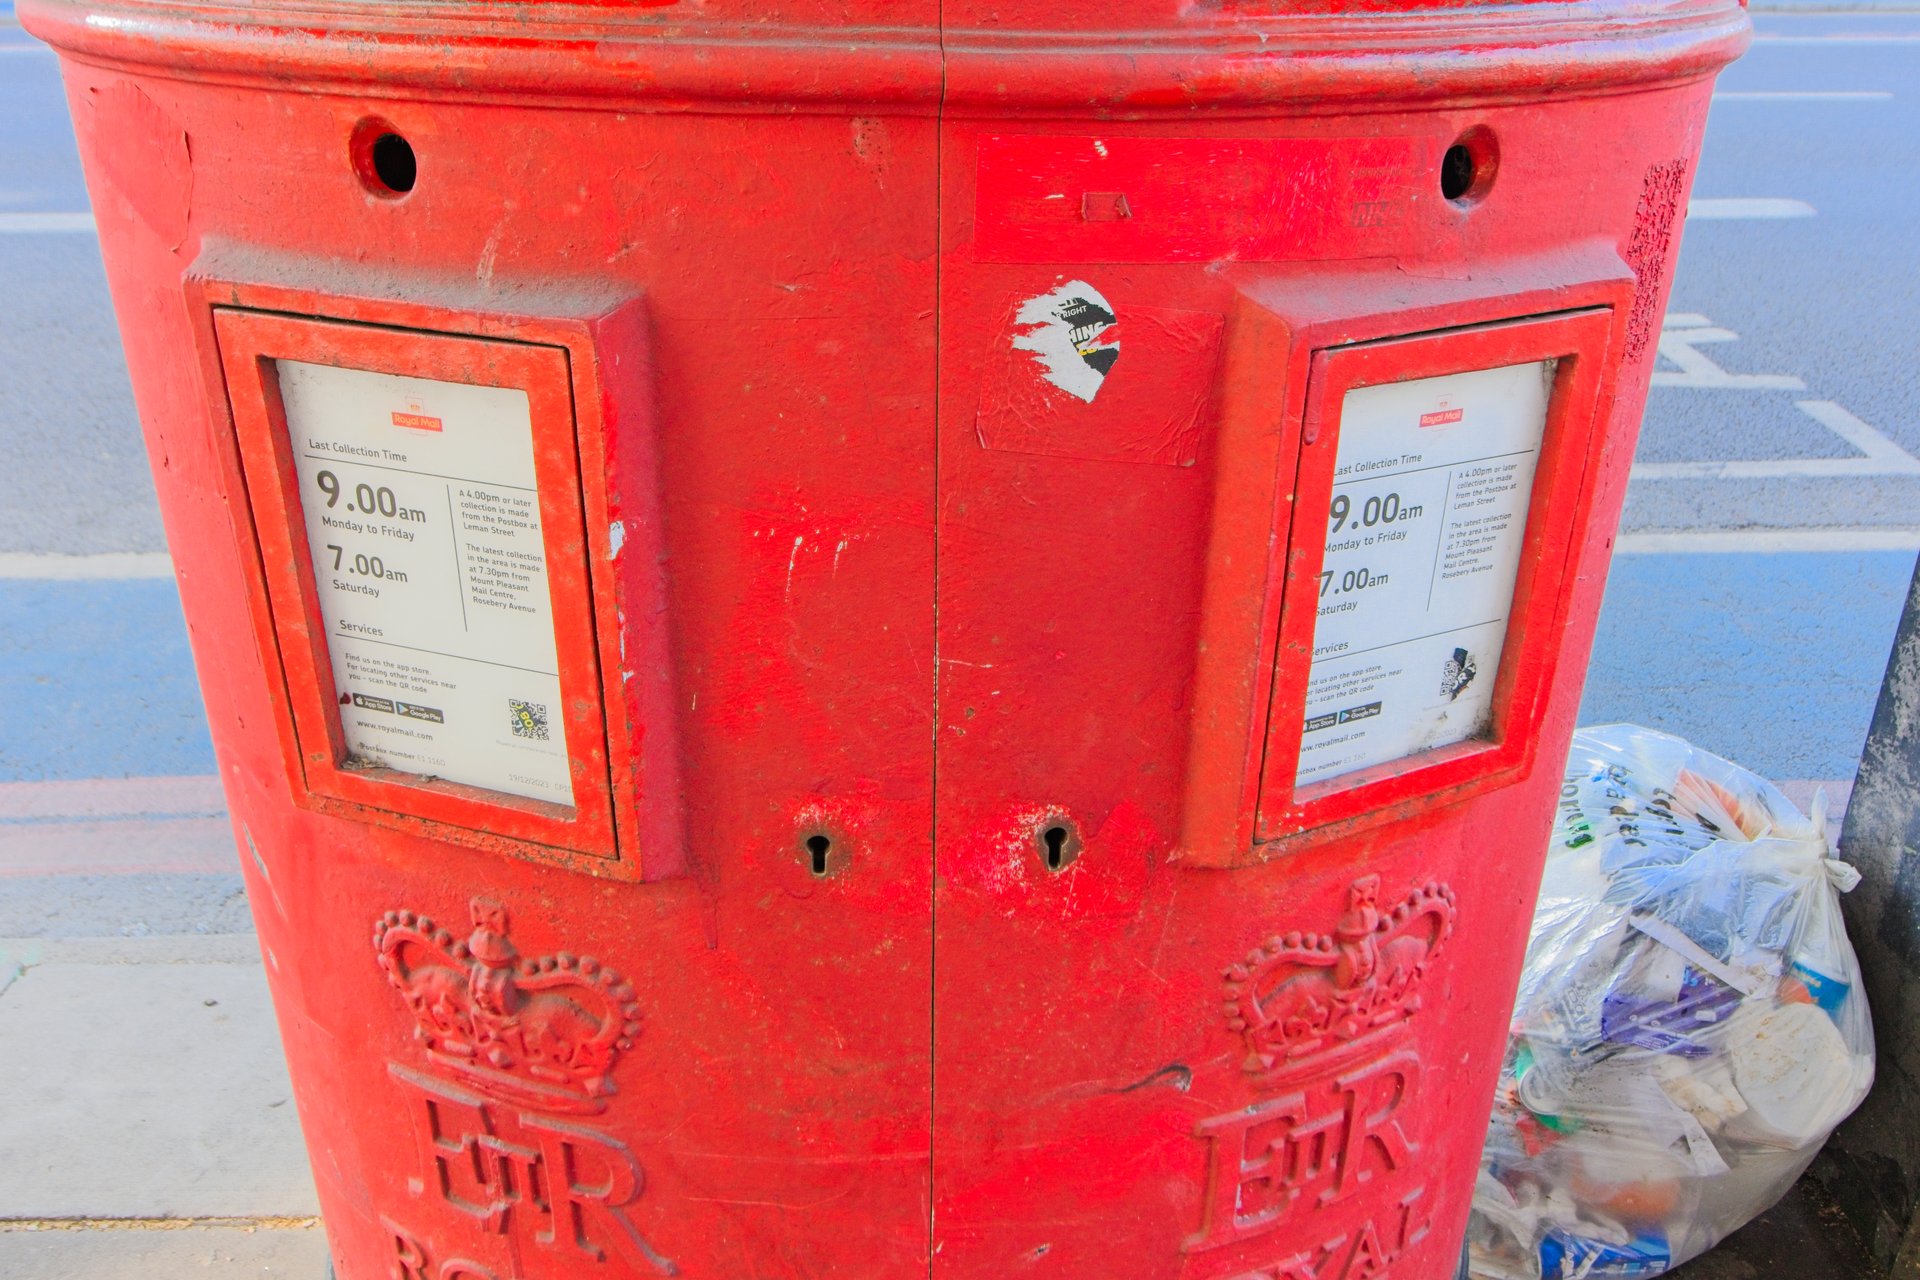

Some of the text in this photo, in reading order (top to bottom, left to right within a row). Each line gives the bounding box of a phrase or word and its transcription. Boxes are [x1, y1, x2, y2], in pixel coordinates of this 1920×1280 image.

[1062, 305, 1087, 318] RIGHT
[393, 413, 439, 428] Royal Mail
[1420, 410, 1461, 426] Royal Mail
[308, 438, 406, 462] Last Collection Time
[1355, 458, 1397, 472] Collection
[1401, 454, 1421, 463] Time
[1459, 471, 1465, 479] A
[1457, 479, 1486, 489] collection
[1484, 485, 1508, 493] Postbox
[317, 470, 425, 521] 9.00am
[466, 490, 499, 502] 4.00pm
[513, 498, 531, 506] later
[1454, 496, 1495, 509] Leman Street
[460, 502, 528, 517] collection is made
[1332, 493, 1421, 532] 9.00am
[462, 511, 480, 520] from
[497, 516, 527, 527] Postbox
[1464, 518, 1481, 526] latest
[1483, 513, 1511, 522] collection
[321, 515, 414, 541] Monday to Friday
[463, 522, 514, 536] Leman Street
[1449, 531, 1455, 539] in
[1364, 537, 1373, 545] to
[1377, 530, 1406, 542] Friday
[466, 543, 542, 561] The latest collection
[1445, 545, 1492, 559] Mount Pleasant
[327, 544, 407, 581] 7.00am
[467, 553, 474, 561] in
[519, 564, 539, 572] made
[1443, 561, 1456, 569] Mail
[479, 566, 509, 577] 7.30pm
[511, 572, 529, 581] from
[1442, 564, 1493, 579] Rosebery Avenue
[332, 579, 379, 597] Saturday
[470, 575, 528, 591] Mount Pleasant
[1320, 568, 1387, 596] 7.00am
[471, 586, 516, 600] Mail Centre,
[473, 596, 535, 613] Rosebery Avenue
[339, 619, 382, 635] Services
[345, 652, 359, 661] Find
[359, 665, 387, 677] locating
[410, 676, 438, 685] services
[1315, 684, 1340, 693] locating
[1342, 679, 1359, 687] other
[1361, 673, 1386, 683] services
[1320, 694, 1334, 702] scan
[1359, 684, 1374, 692] code
[355, 719, 432, 739] www.royalmail.com
[389, 750, 414, 759] number
